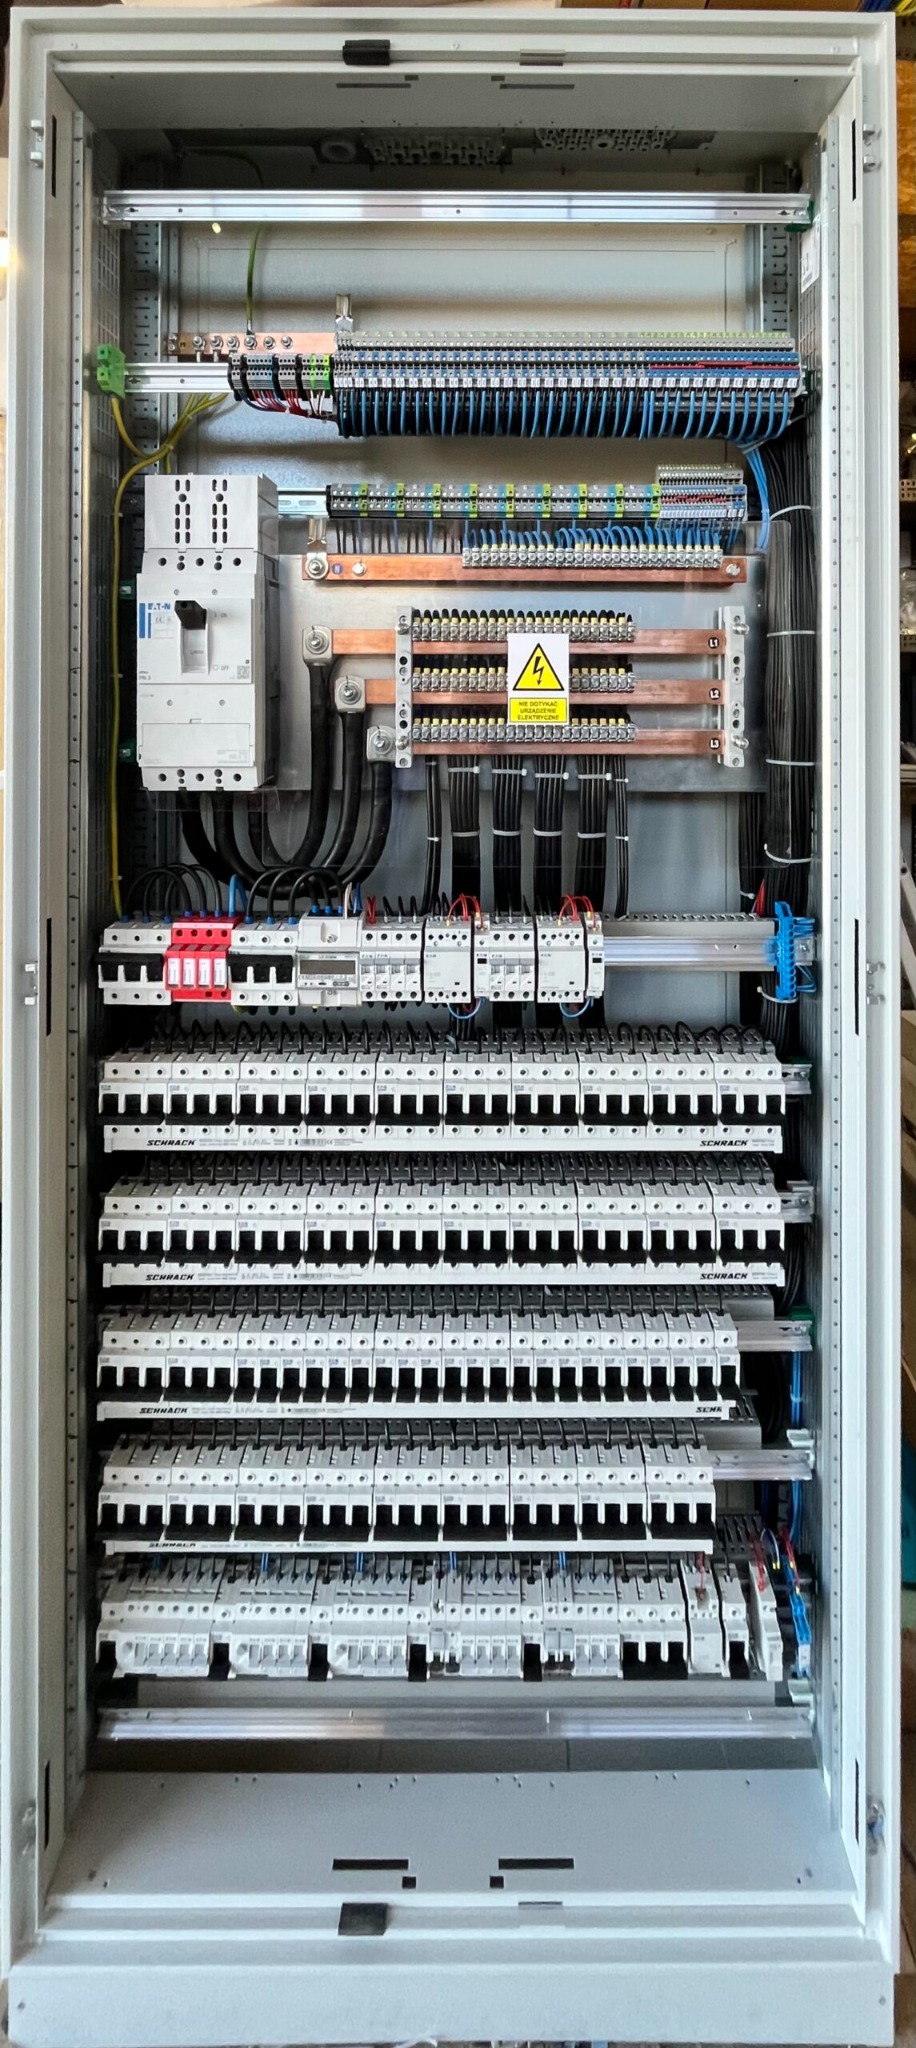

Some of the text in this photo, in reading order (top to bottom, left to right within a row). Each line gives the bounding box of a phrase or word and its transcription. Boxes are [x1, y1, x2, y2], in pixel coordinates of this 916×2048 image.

[709, 639, 718, 647] L1
[710, 690, 719, 699] L2
[710, 740, 719, 748] L3
